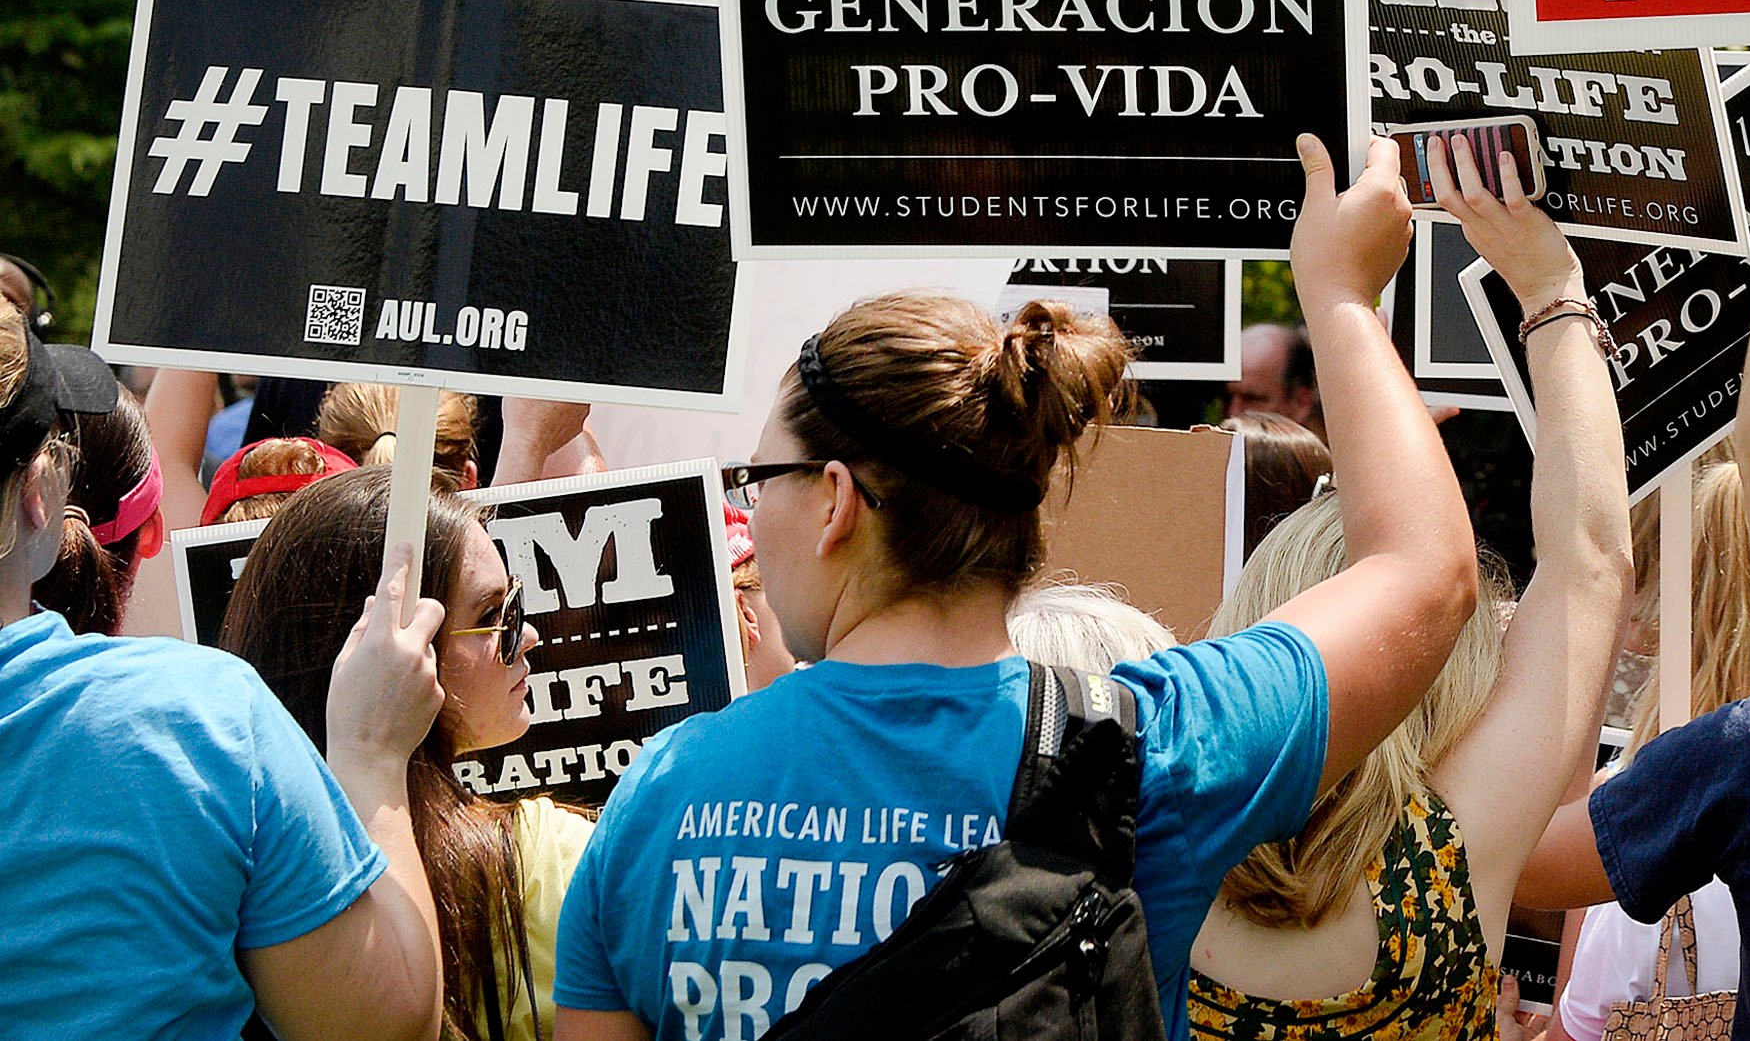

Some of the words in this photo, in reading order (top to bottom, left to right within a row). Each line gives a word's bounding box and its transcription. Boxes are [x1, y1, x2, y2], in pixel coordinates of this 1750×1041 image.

[1450, 22, 1497, 46] the
[850, 63, 1264, 118] PRO-VIDA
[1370, 53, 1680, 126] RO-LIFE
[147, 66, 727, 228] #TEAMLIFE
[793, 195, 1299, 220] WWW.STUDENTSFORLIFE.ORG
[374, 300, 529, 351] AUL.ORG
[677, 801, 847, 843] AMERICAN
[862, 808, 929, 844] LIFE
